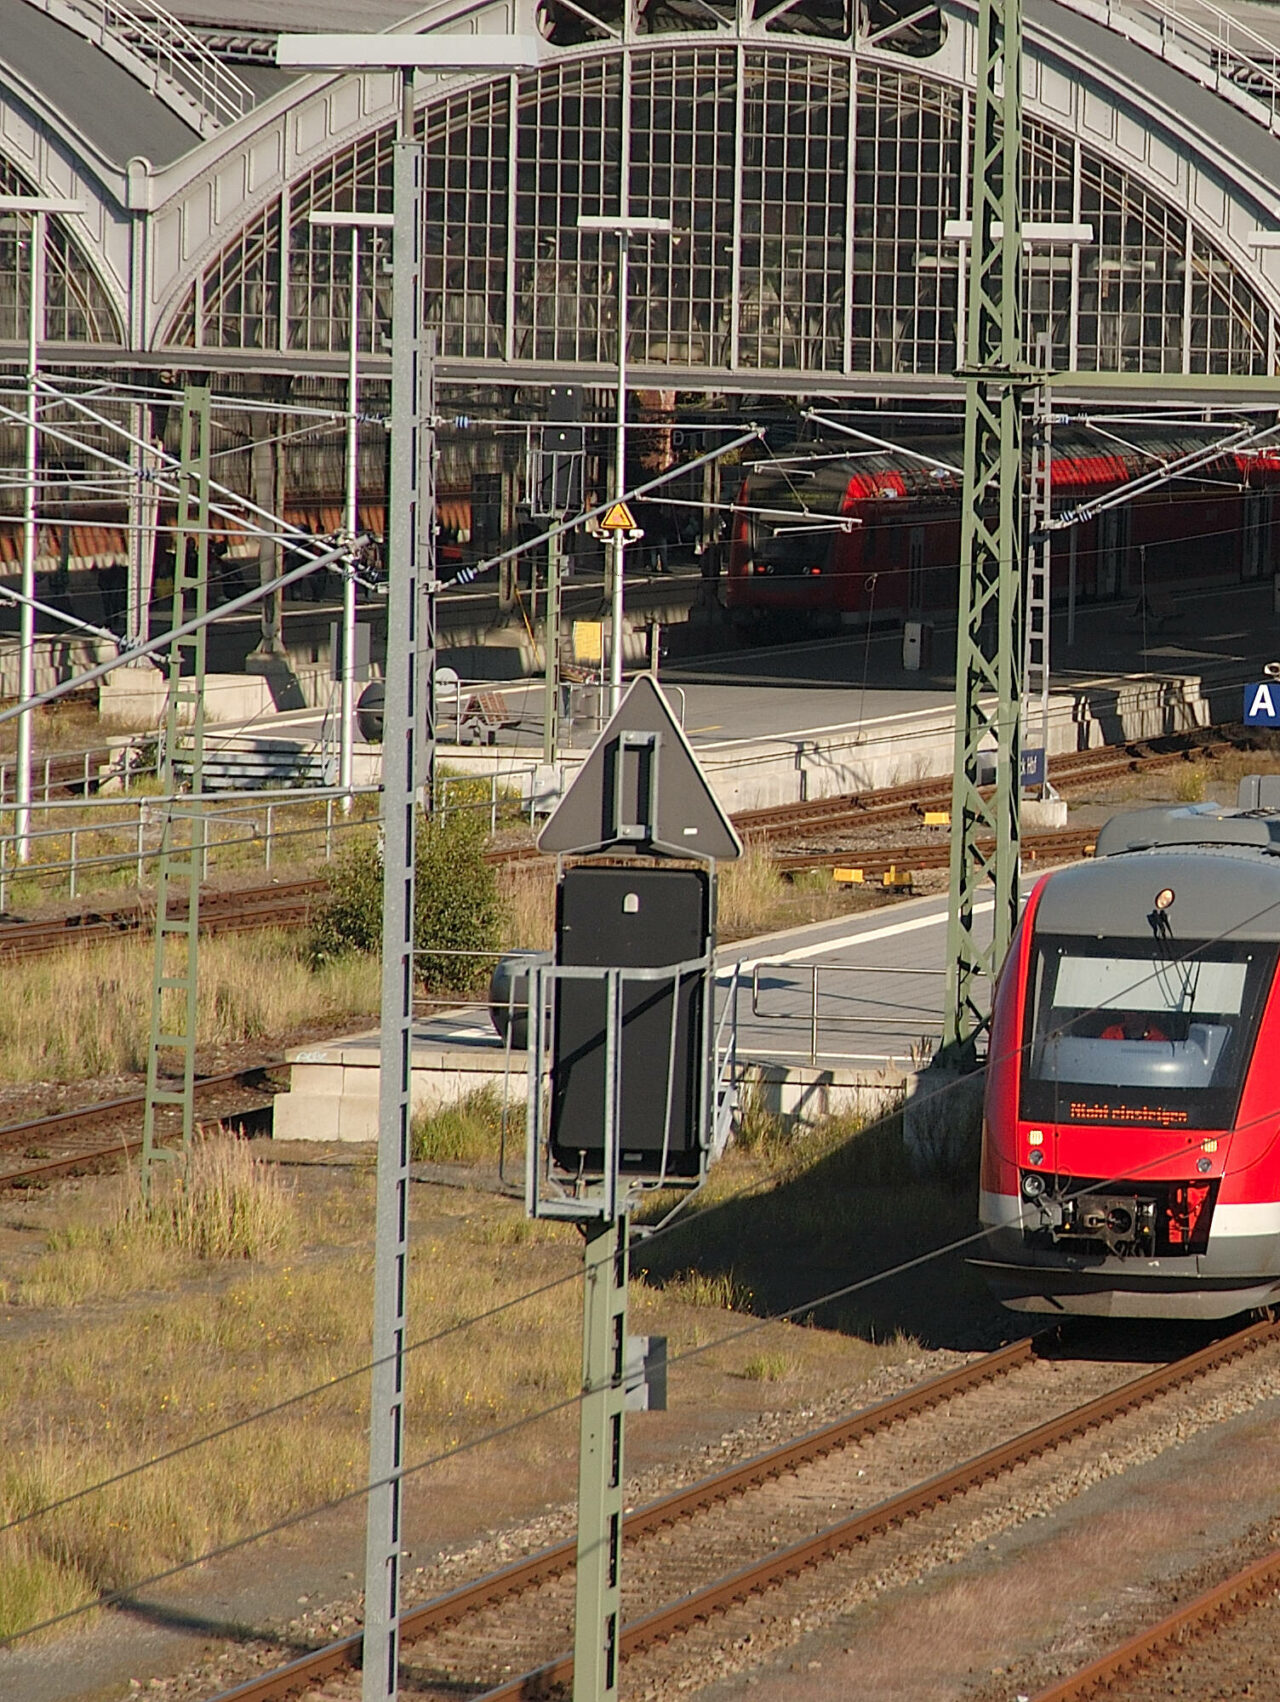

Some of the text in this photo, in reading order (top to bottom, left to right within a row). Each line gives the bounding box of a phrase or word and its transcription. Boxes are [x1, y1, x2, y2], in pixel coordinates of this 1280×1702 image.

[1249, 684, 1276, 717] A
[1070, 1102, 1188, 1126] Nicht einsteigen
